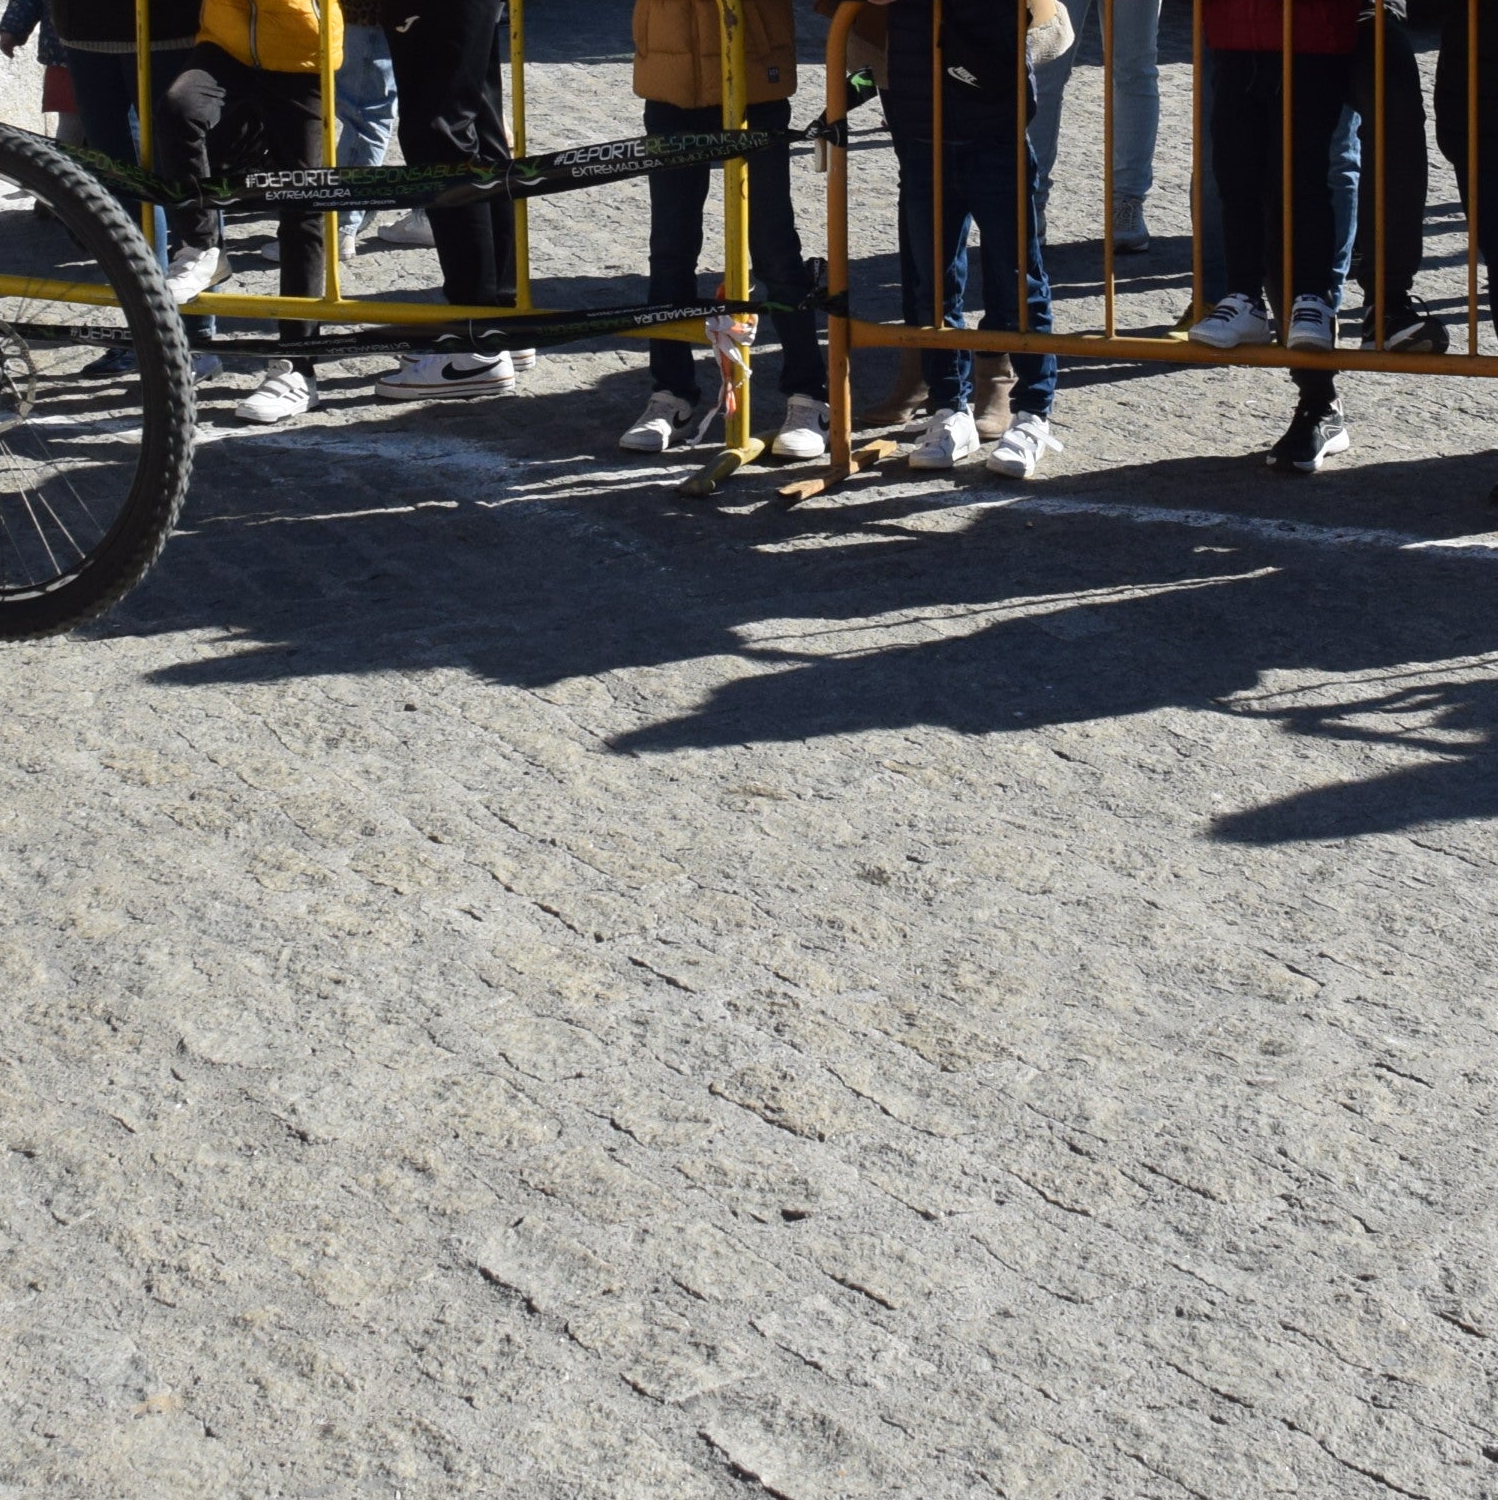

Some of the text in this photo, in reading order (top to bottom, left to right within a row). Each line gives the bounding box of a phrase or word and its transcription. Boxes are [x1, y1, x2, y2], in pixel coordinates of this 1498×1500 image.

[572, 159, 664, 177] EXTREMADURA
[265, 189, 351, 200] EXTREMADURA
[634, 305, 725, 324] EXTREMADURA
